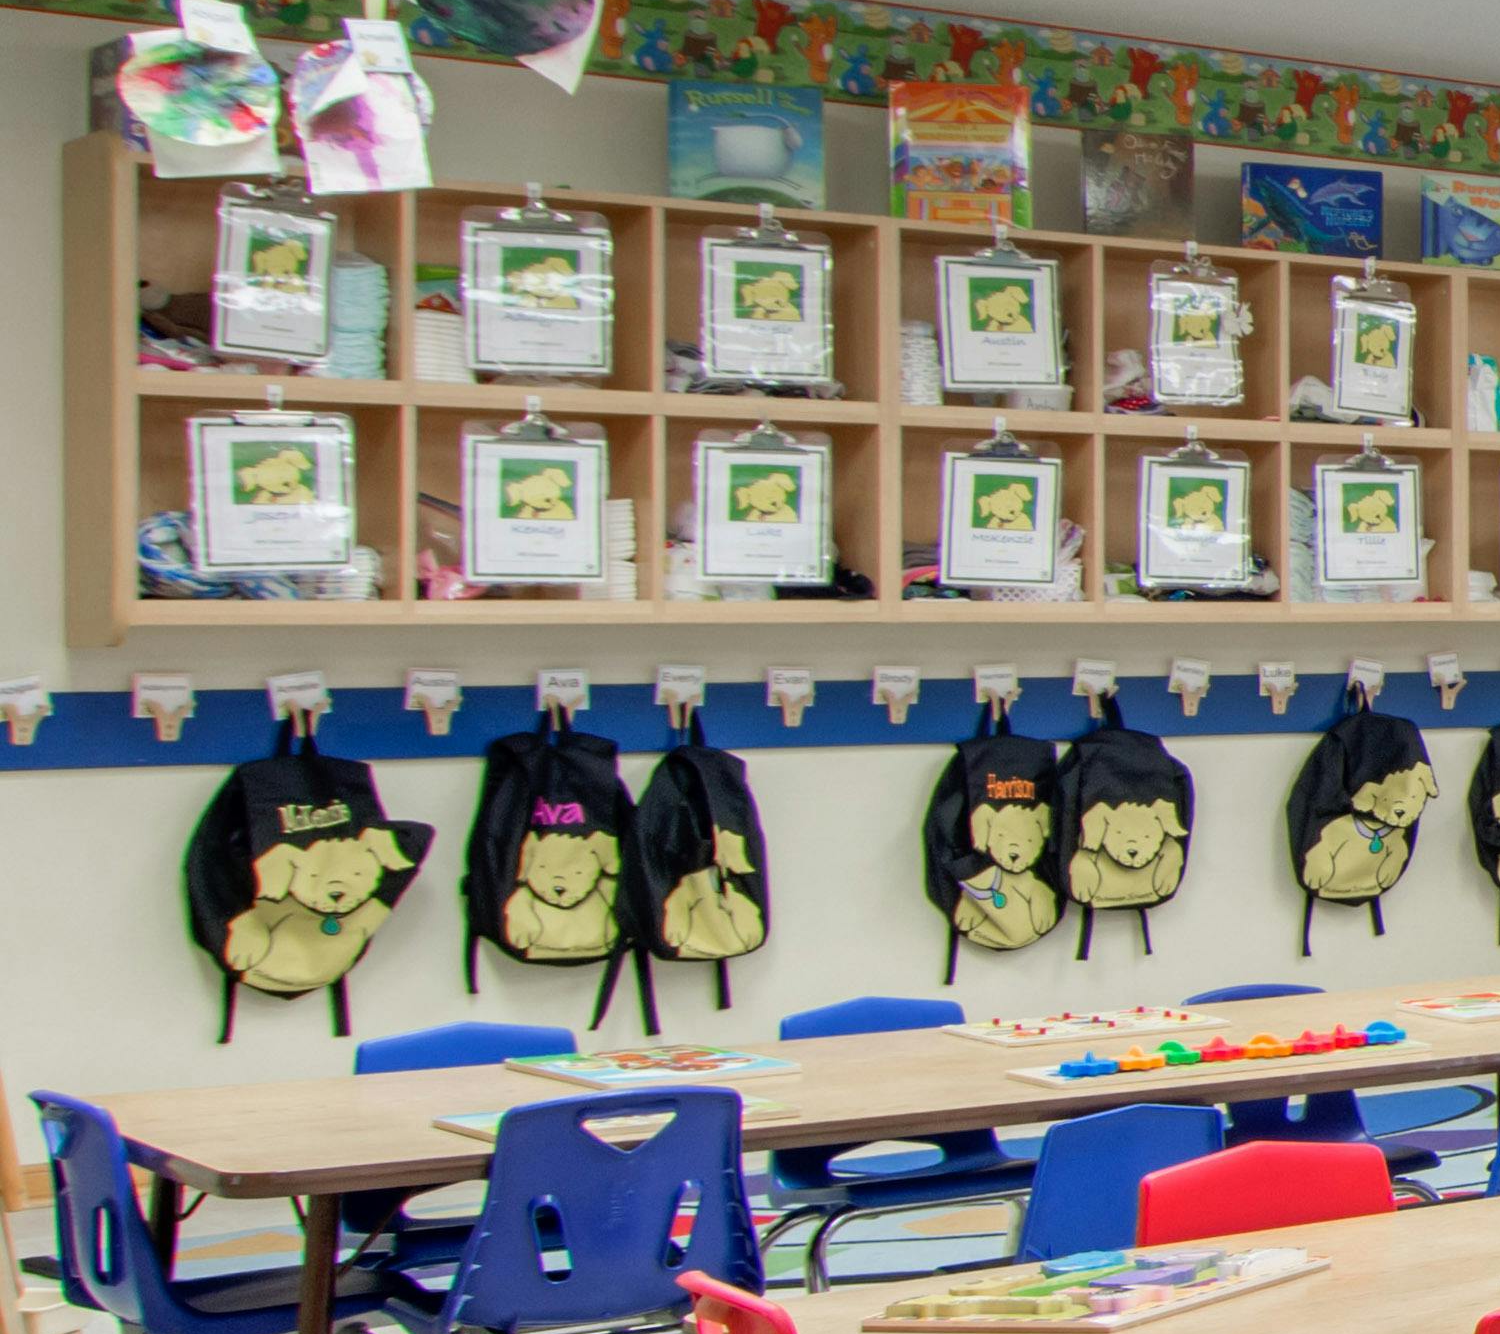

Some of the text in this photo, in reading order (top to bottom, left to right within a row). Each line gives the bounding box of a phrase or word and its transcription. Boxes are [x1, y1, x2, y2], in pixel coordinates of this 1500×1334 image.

[685, 88, 774, 108] Russell
[1261, 667, 1292, 678] Luke
[548, 676, 580, 688] Ava
[773, 673, 808, 685] Evan
